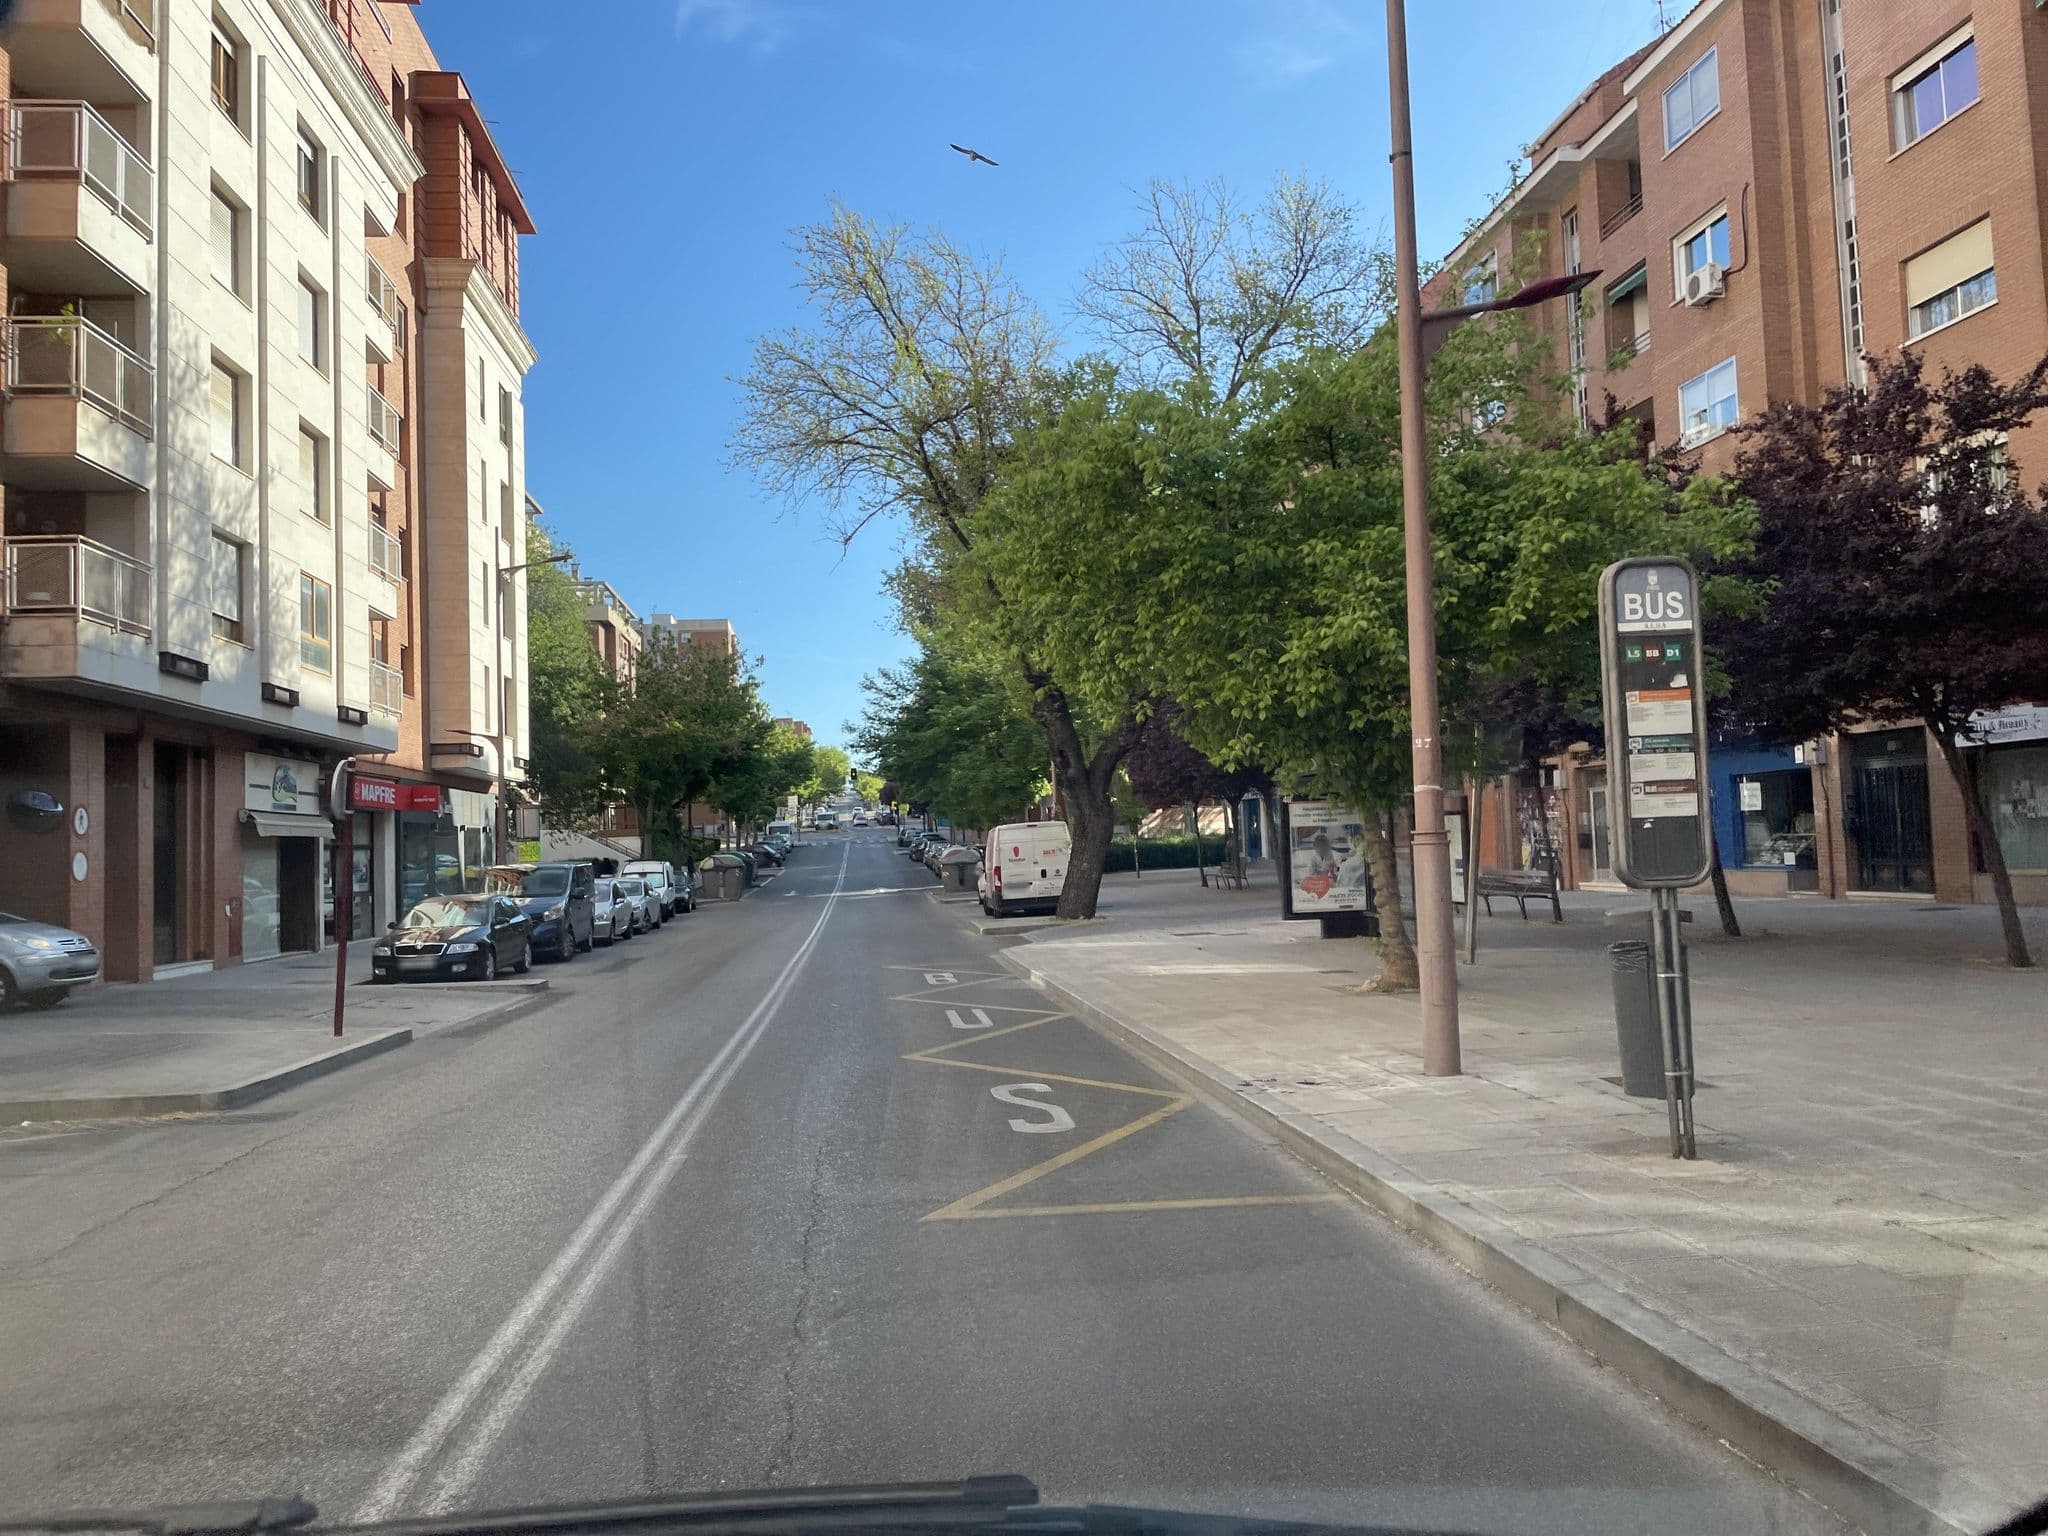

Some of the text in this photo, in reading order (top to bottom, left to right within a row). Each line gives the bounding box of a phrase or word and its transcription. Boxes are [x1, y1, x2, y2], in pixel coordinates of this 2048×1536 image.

[1624, 591, 1685, 620] BUS
[1666, 648, 1680, 657] D1
[361, 783, 396, 804] MAPFRE
